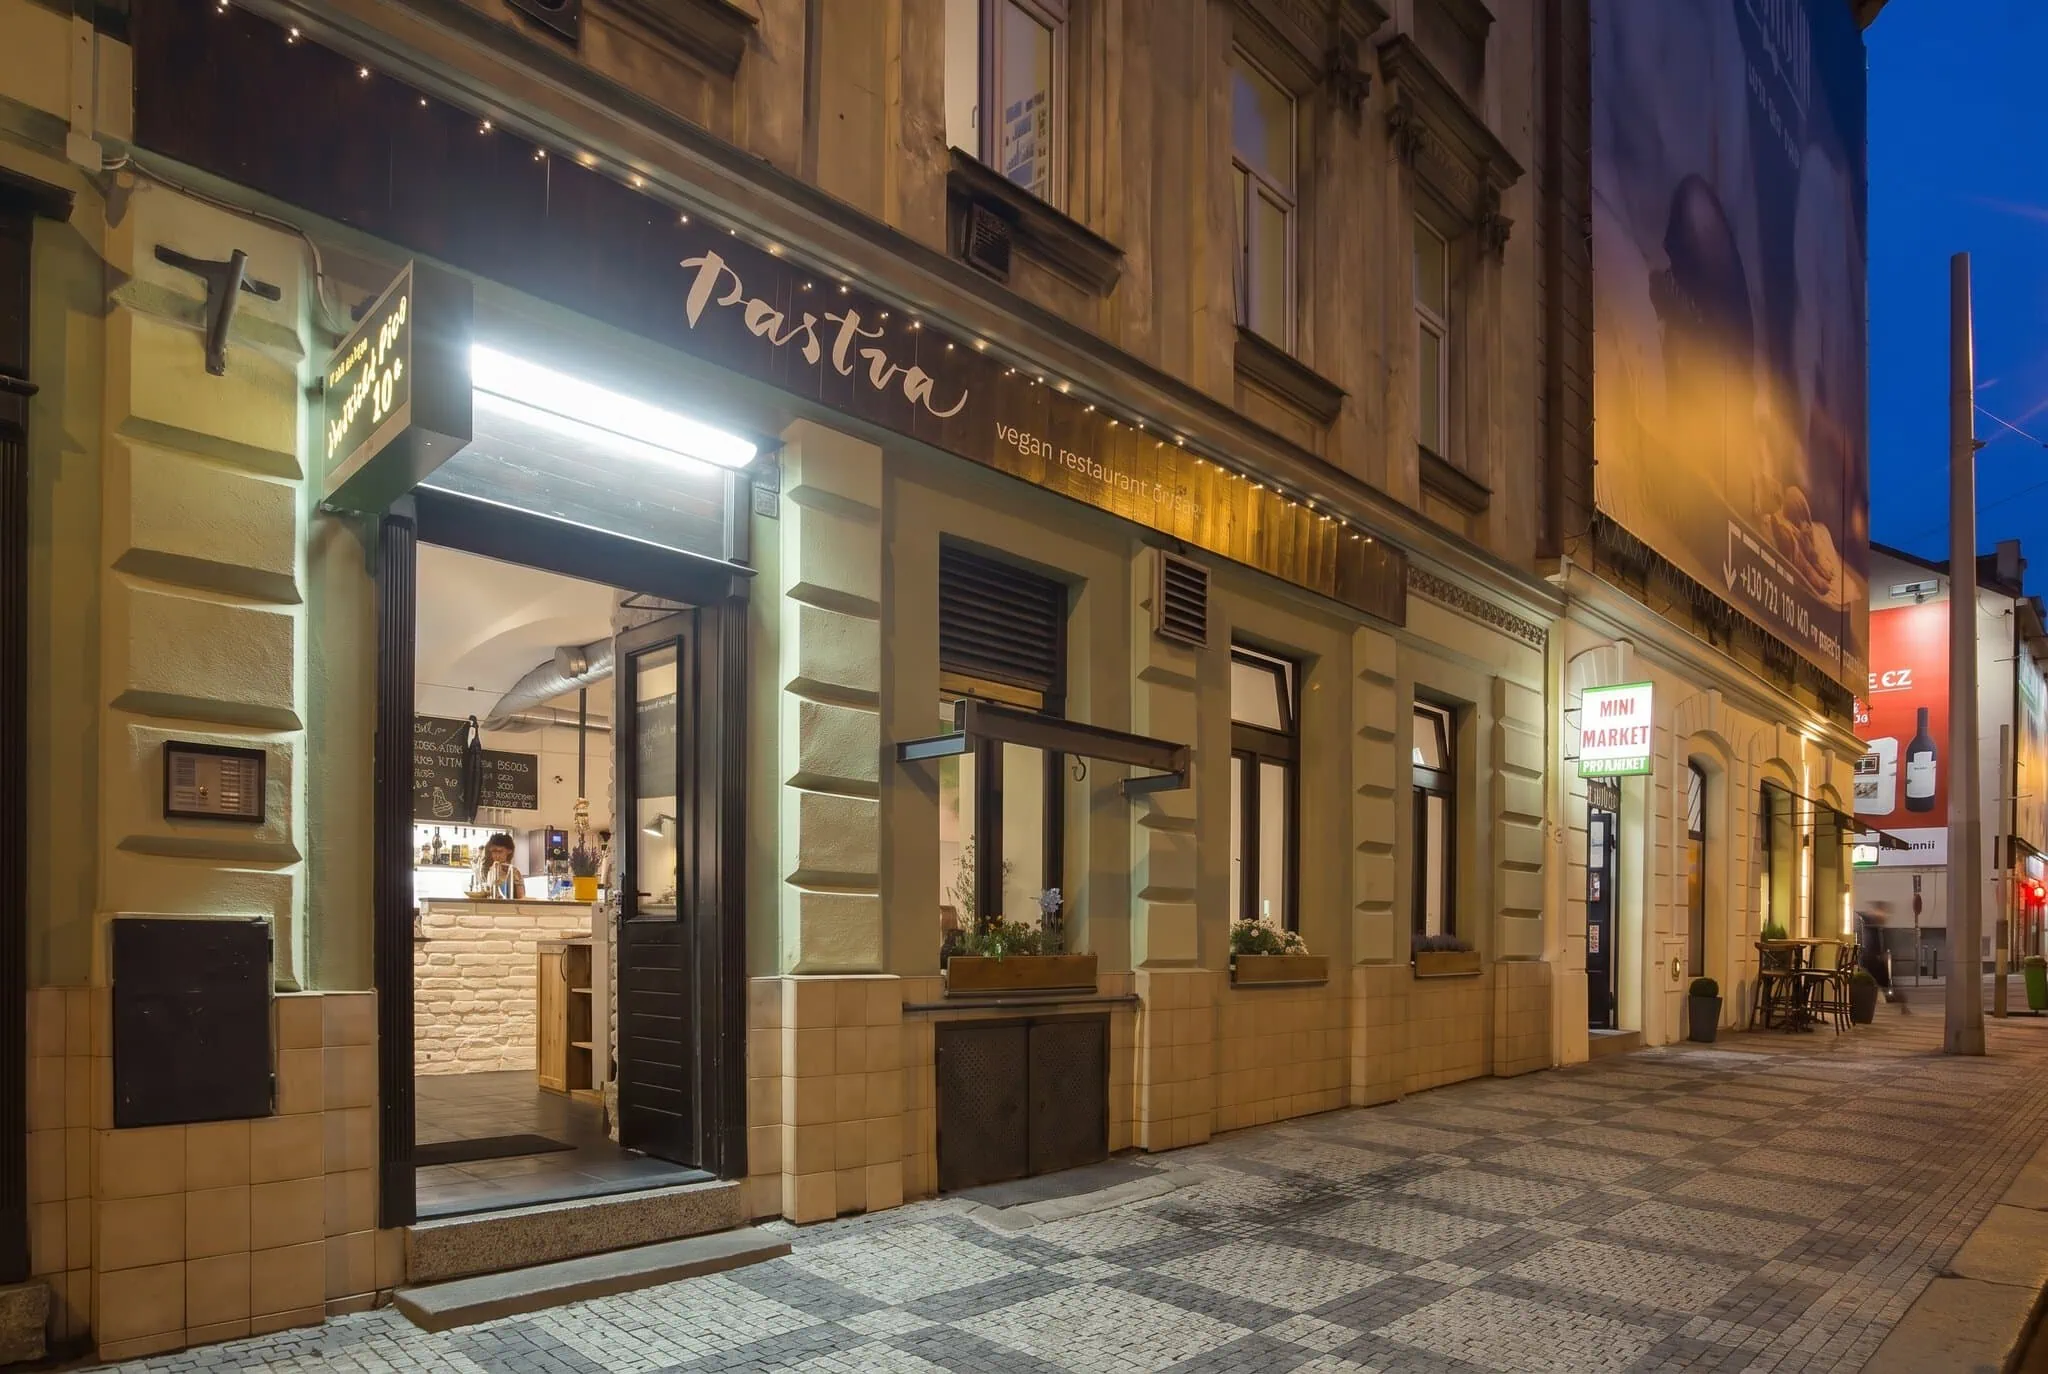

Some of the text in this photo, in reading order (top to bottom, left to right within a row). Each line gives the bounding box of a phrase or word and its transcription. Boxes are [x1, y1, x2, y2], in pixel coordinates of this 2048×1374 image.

[680, 250, 968, 417] Pastva
[996, 421, 1053, 461] vegan
[1059, 448, 1148, 498] restaurant
[1600, 697, 1635, 718] MINI
[1582, 725, 1649, 749] MARKET
